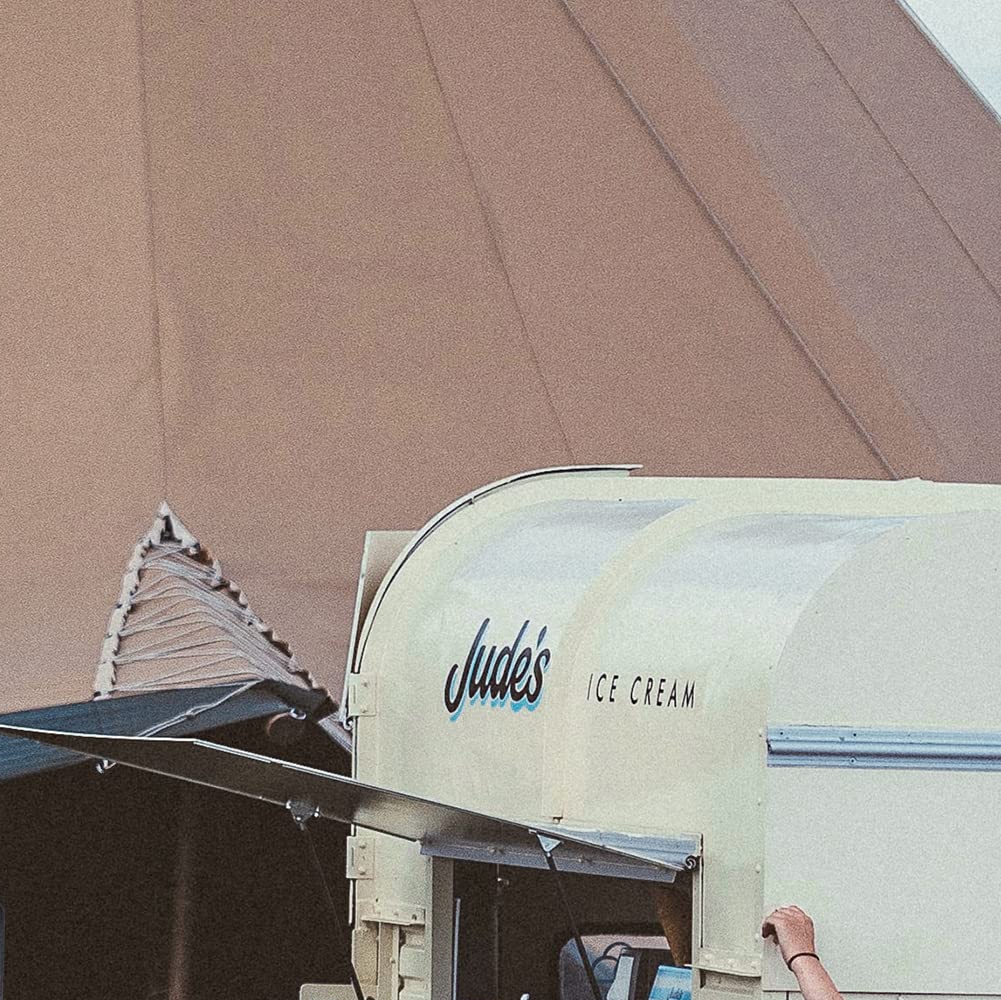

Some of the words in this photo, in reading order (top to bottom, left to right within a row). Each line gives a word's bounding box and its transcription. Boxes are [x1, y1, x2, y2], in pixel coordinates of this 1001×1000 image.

[444, 617, 551, 721] Jude's
[586, 673, 619, 703] ICE
[630, 675, 696, 709] CREAM
